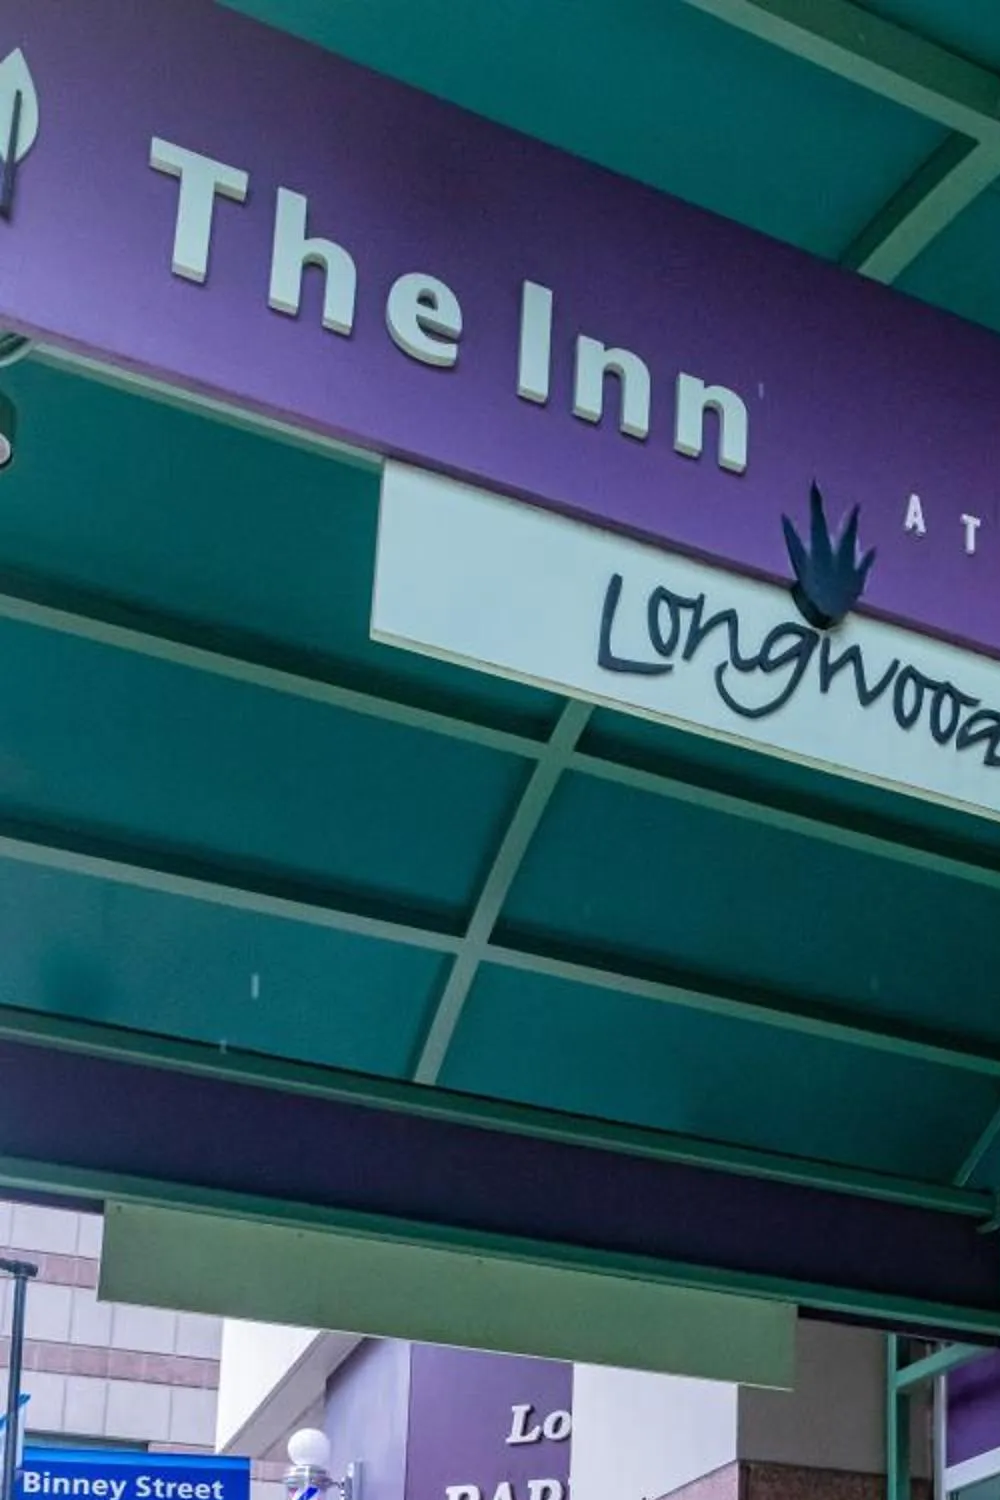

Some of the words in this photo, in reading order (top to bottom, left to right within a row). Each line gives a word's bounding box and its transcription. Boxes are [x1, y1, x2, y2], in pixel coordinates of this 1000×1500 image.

[150, 136, 463, 368] The
[516, 279, 749, 474] Inn
[904, 493, 982, 554] AT
[135, 1475, 225, 1500] Street
